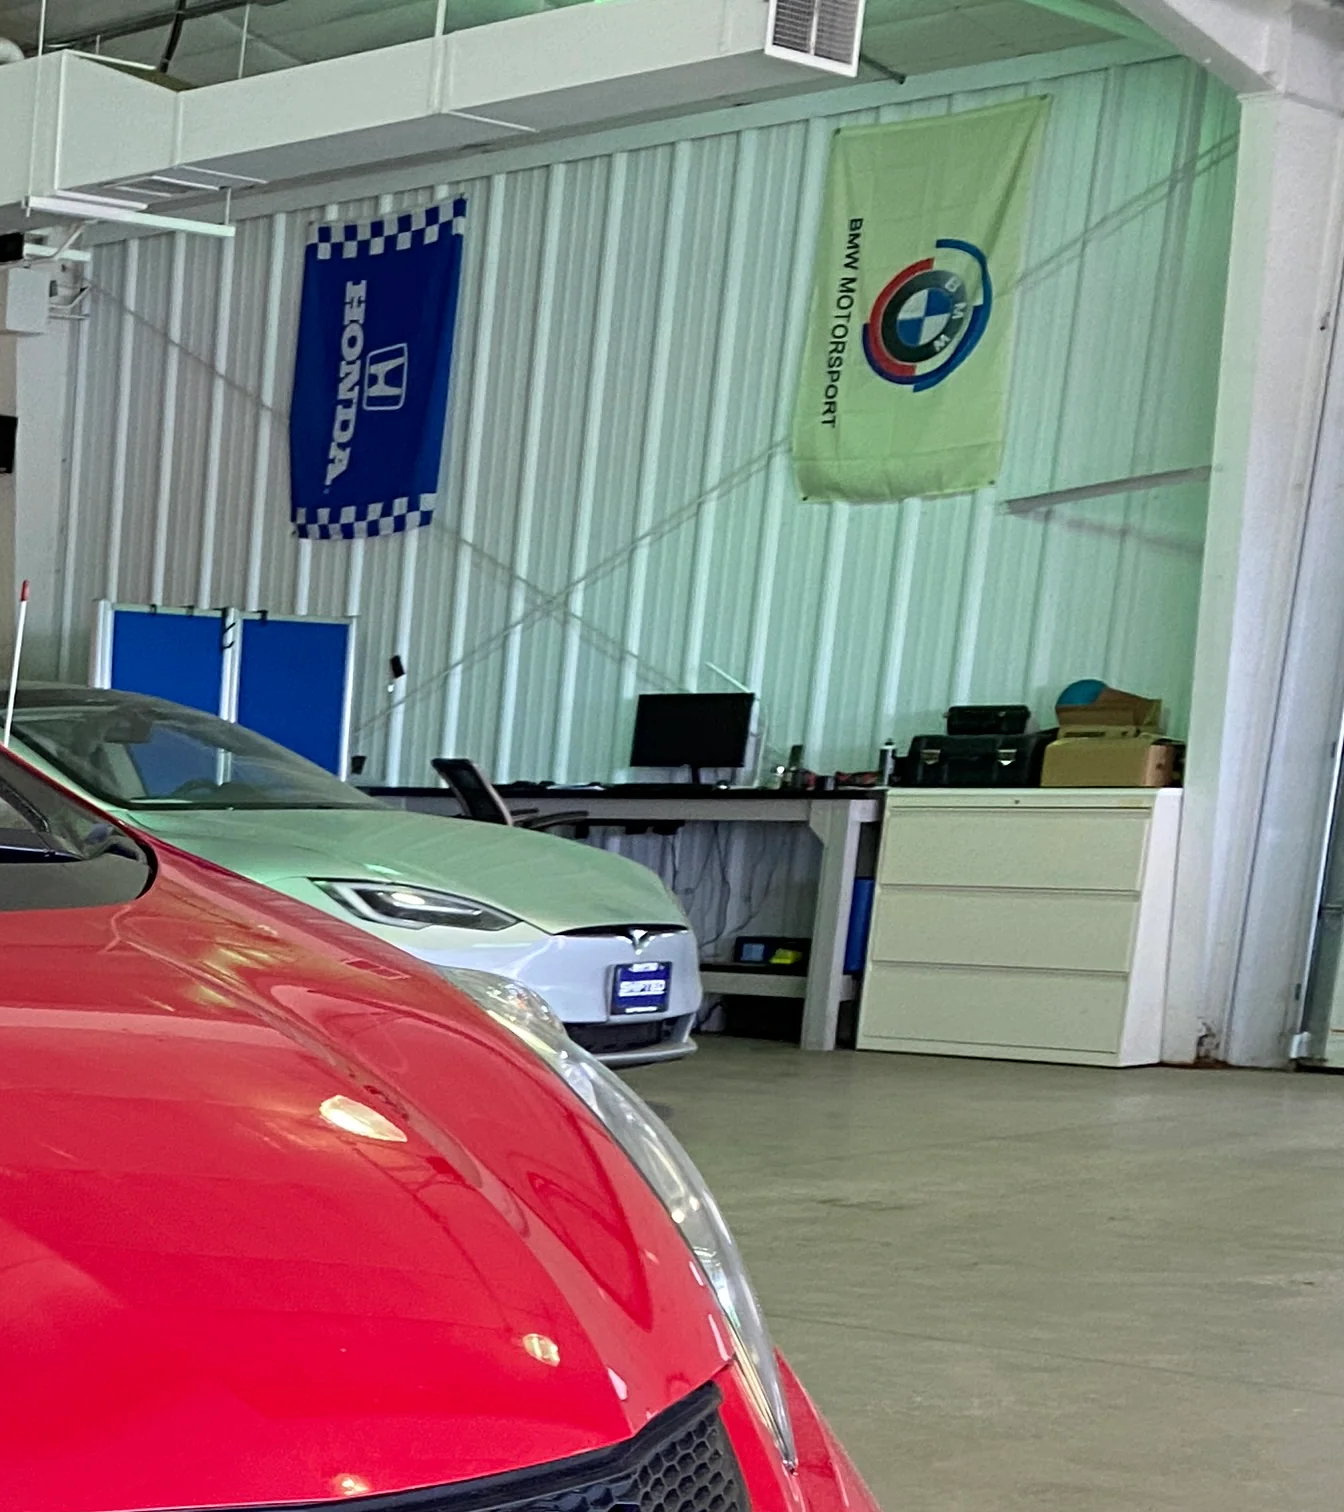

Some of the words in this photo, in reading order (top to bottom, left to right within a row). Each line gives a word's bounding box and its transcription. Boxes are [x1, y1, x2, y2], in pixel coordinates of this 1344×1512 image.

[843, 217, 864, 271] BMW
[324, 279, 367, 486] HONDA
[820, 276, 858, 429] MOTORSPORT
